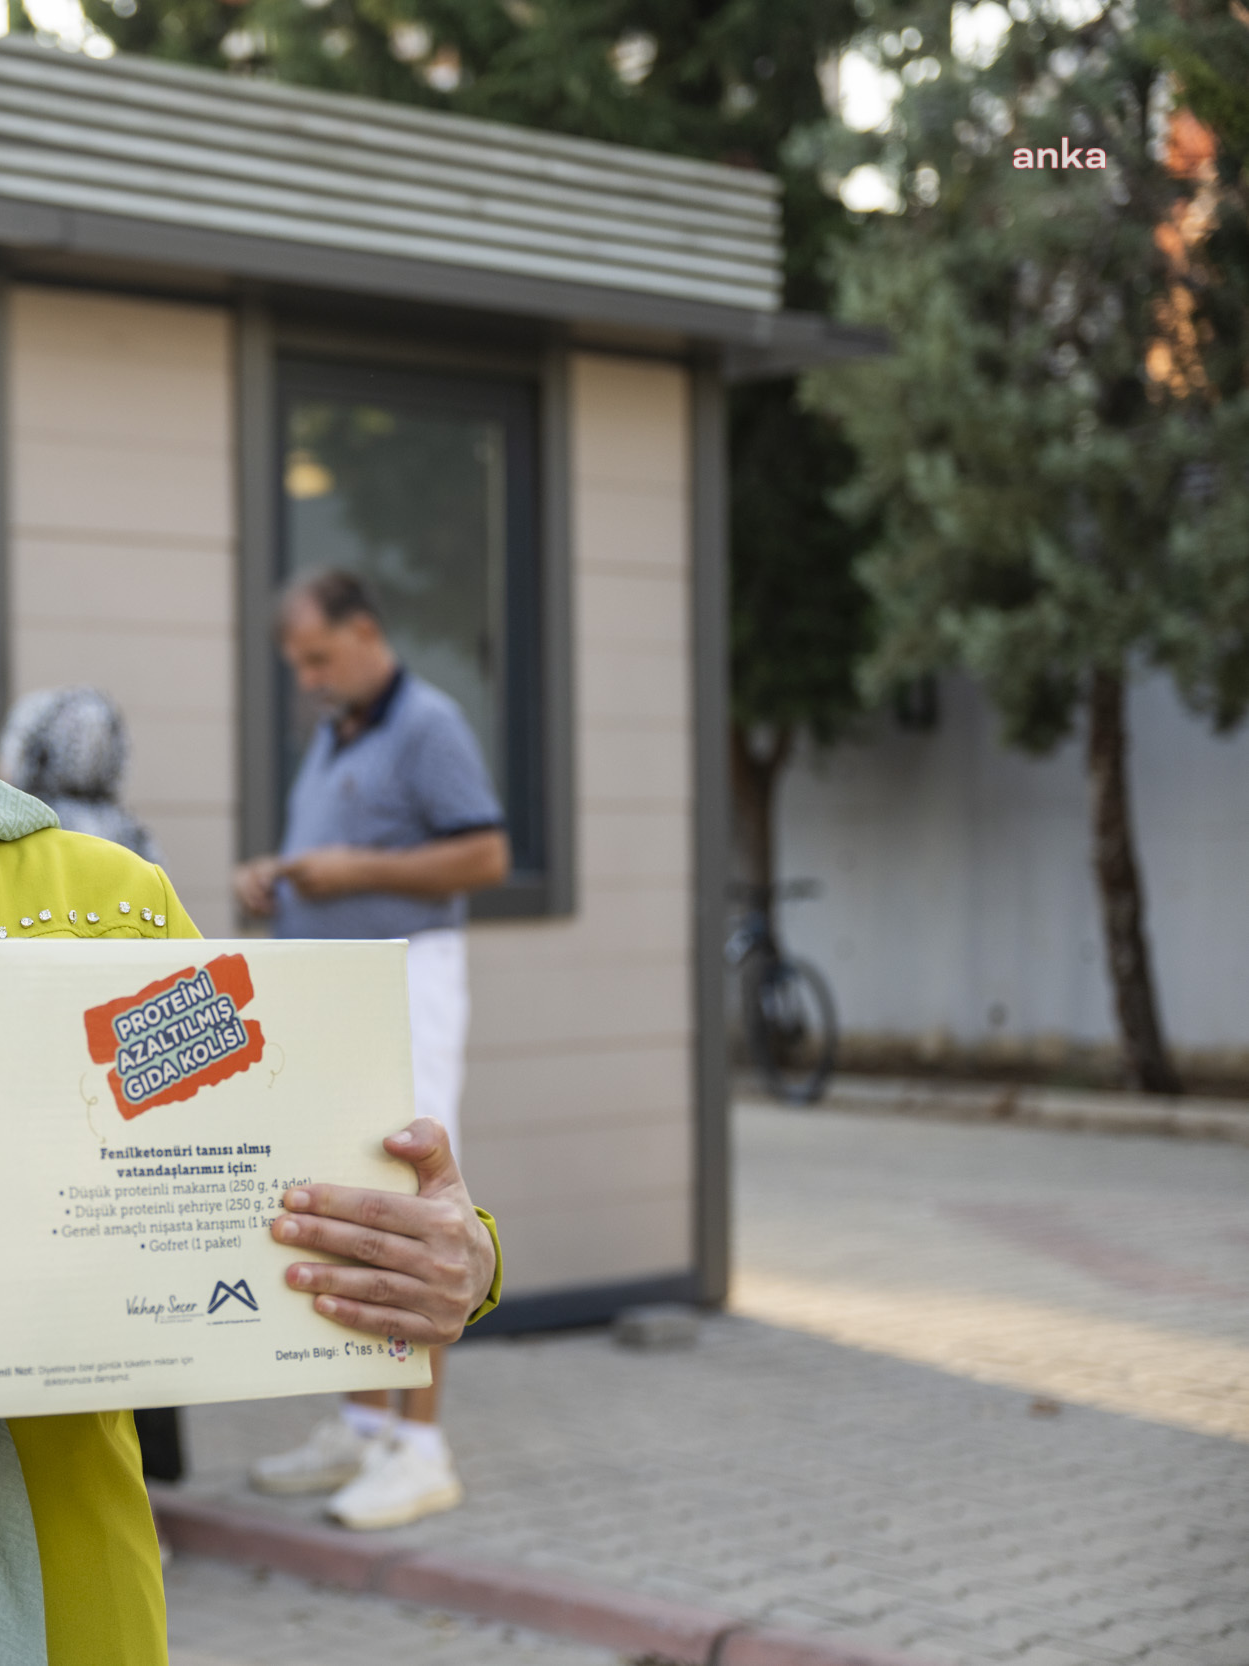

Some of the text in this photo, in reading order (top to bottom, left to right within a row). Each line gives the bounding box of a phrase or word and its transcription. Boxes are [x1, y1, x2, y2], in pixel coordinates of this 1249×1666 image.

[116, 973, 213, 1041] PROTEİNİ
[119, 998, 233, 1074] AZALTILMIŞ
[125, 1019, 245, 1099] GIDA KOLİSİ
[100, 1143, 271, 1160] Fenilketonüri tanısı almış
[116, 1161, 257, 1179] vatandaşlarımız için:
[68, 1185, 111, 1201] Düşük
[114, 1183, 169, 1201] proteinli
[172, 1182, 226, 1195] makarna
[229, 1179, 255, 1193] (250
[271, 1179, 278, 1189] 4
[75, 1203, 117, 1220] Düşük
[120, 1202, 175, 1219] proteinli
[178, 1200, 223, 1216] şehriye
[225, 1198, 251, 1212] (250
[267, 1197, 275, 1209] 2
[61, 1223, 100, 1238] Genel
[103, 1222, 146, 1237] amaçlı
[150, 1220, 193, 1235] nişasta
[196, 1218, 246, 1233] karışımı
[149, 1235, 242, 1252] Gofret (1 paket)
[275, 1349, 310, 1362] Detaylı
[313, 1346, 340, 1360] Bilgi:
[355, 1345, 373, 1356] 185
